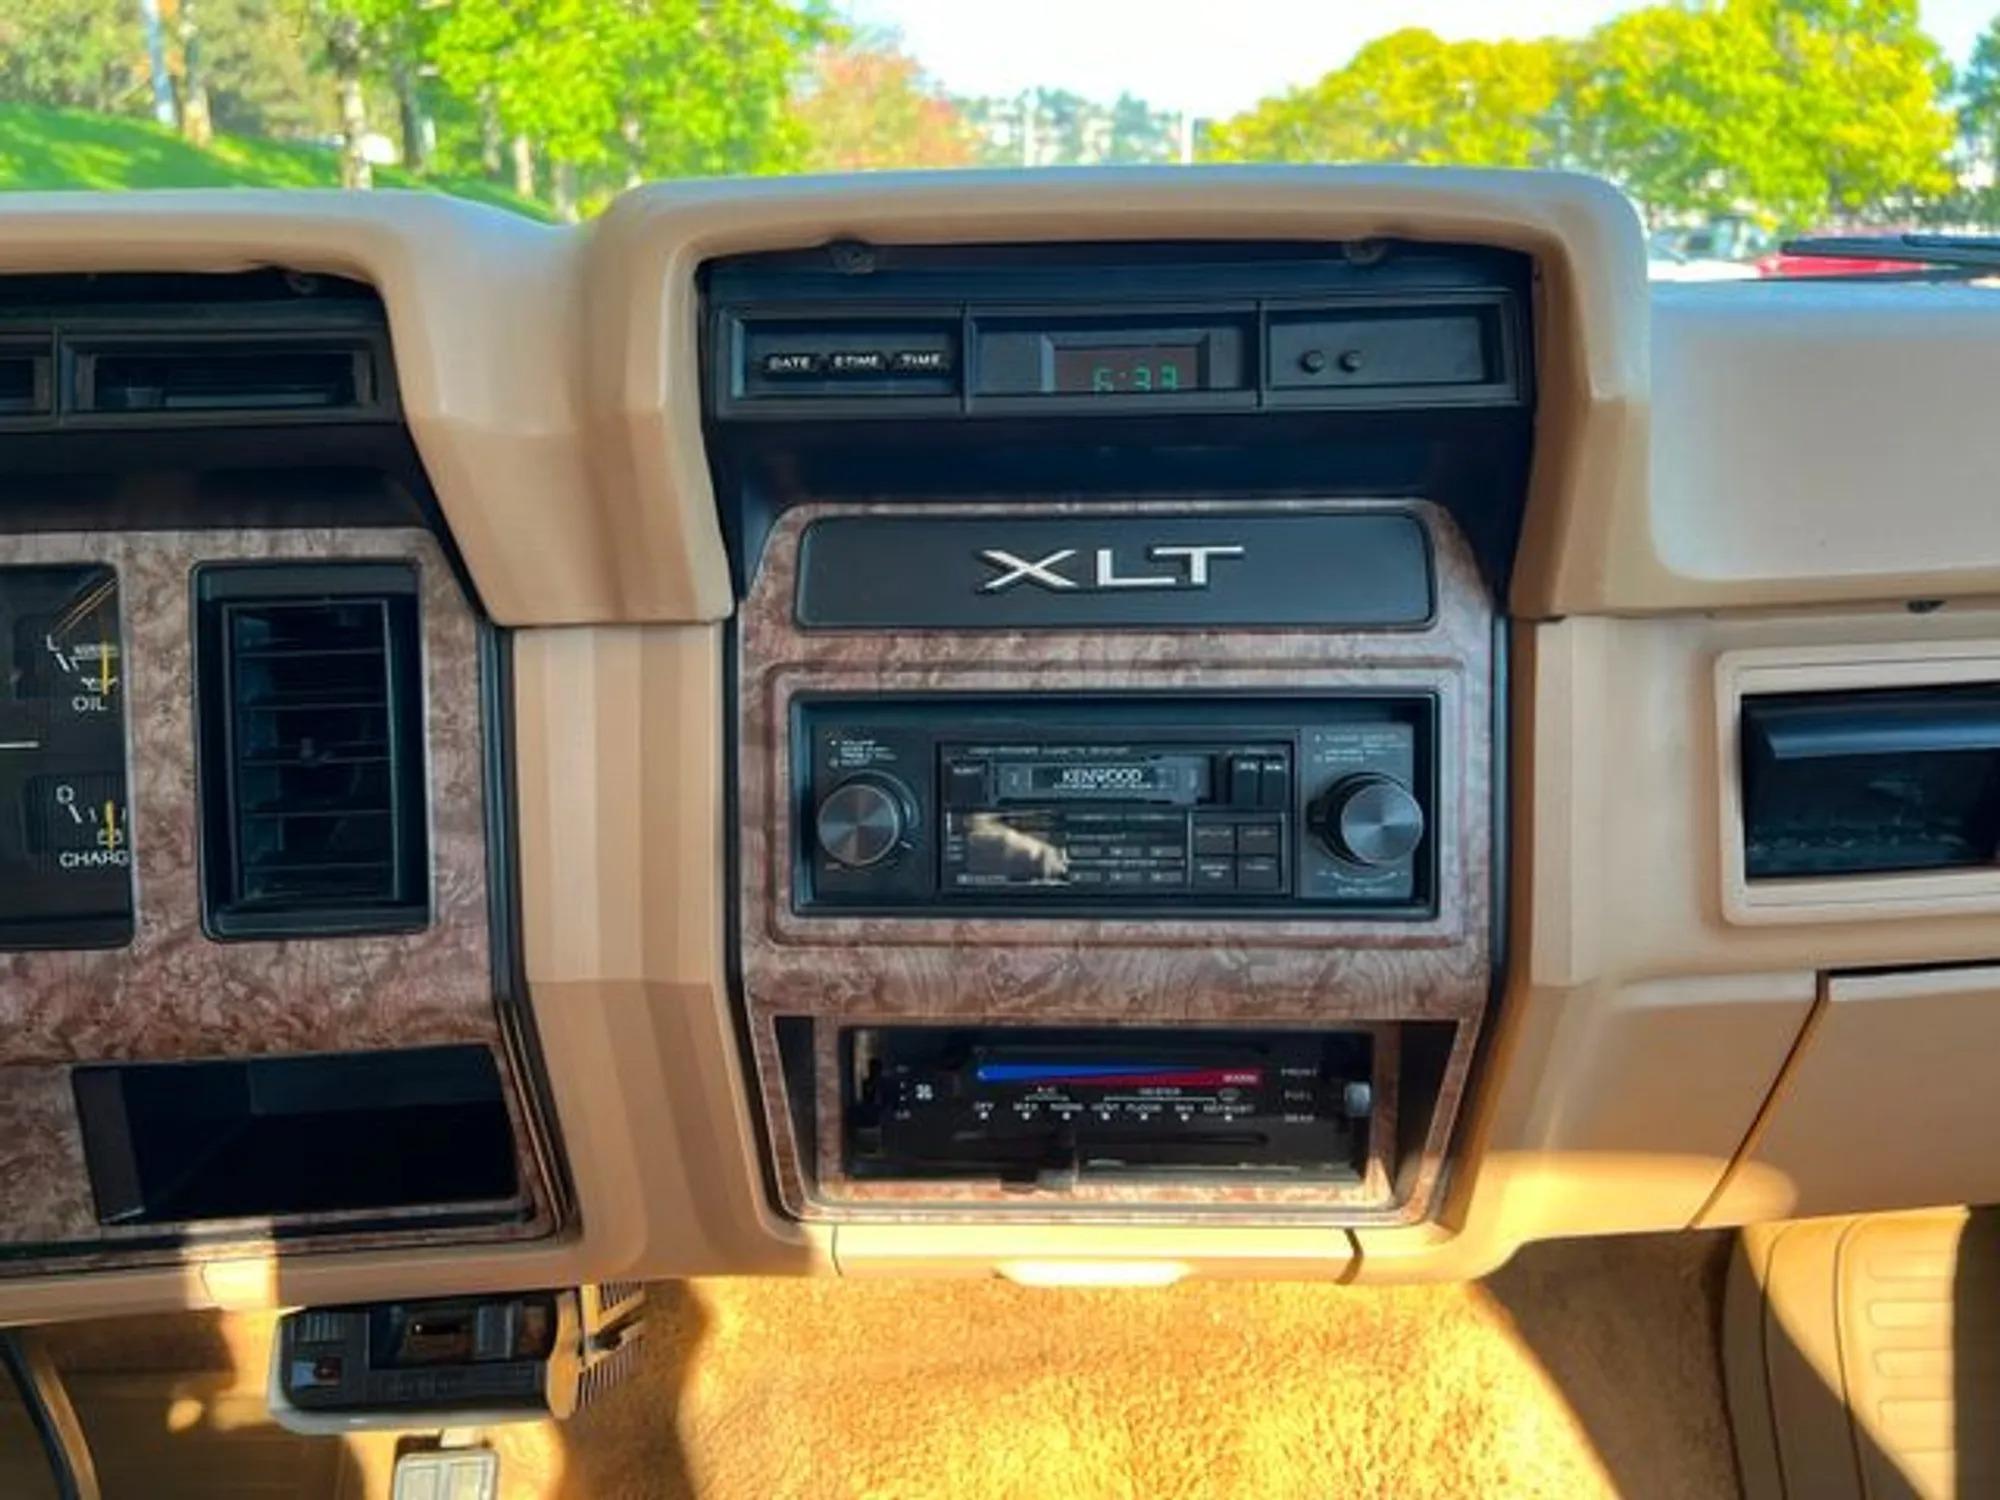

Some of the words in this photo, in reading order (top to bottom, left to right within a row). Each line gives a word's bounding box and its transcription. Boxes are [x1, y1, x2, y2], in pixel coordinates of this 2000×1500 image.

[768, 356, 811, 371] DATE
[902, 353, 942, 366] TIME
[981, 545, 1245, 589] XLT
[46, 634, 60, 651] L
[71, 696, 109, 712] OIL
[1062, 768, 1143, 784] KENWOOD
